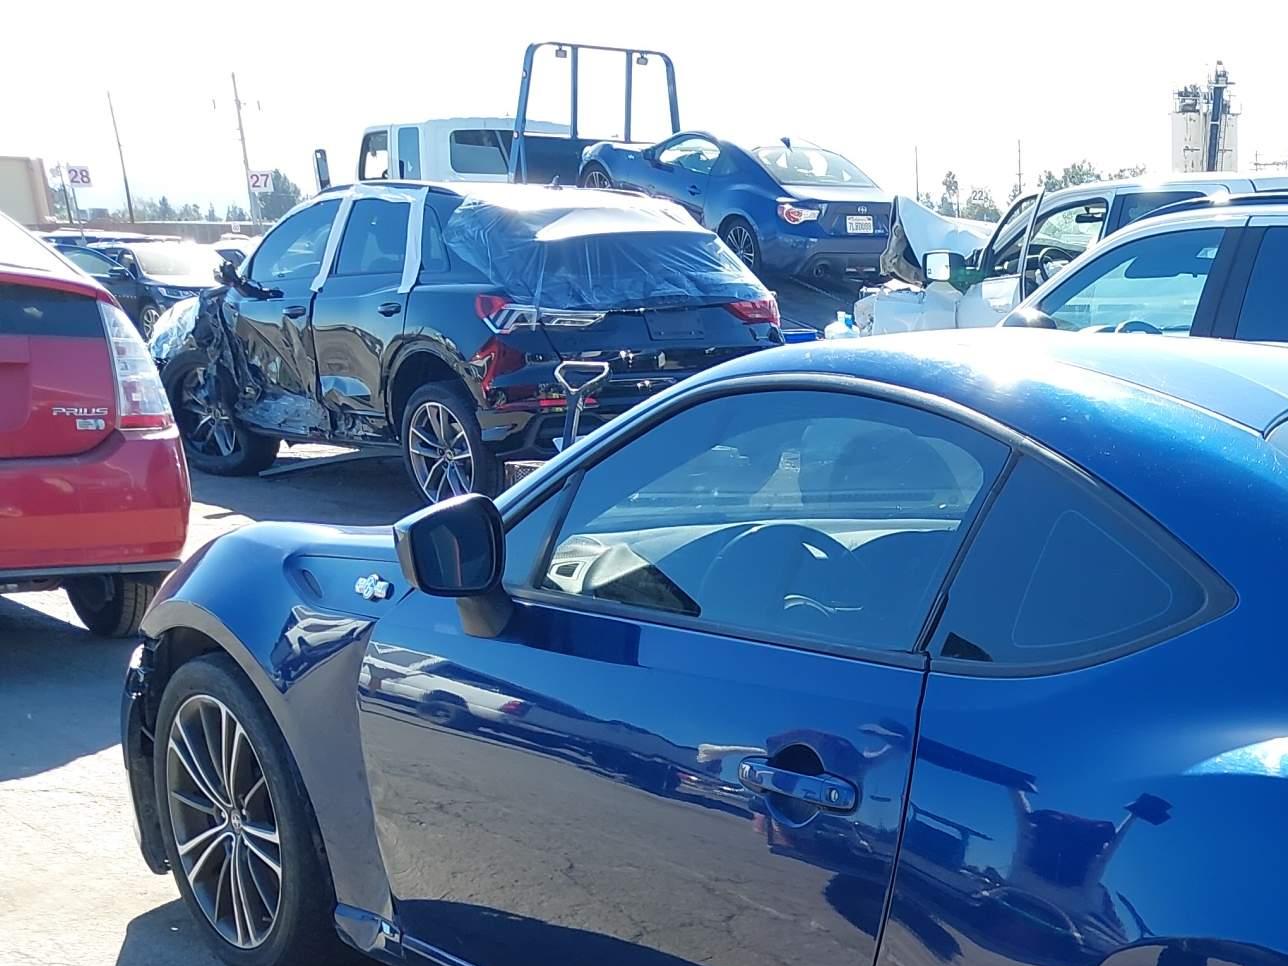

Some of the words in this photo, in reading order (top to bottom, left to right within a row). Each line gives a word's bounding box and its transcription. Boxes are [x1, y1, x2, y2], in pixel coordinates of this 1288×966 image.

[68, 168, 91, 184] 28
[250, 173, 270, 188] 27
[971, 190, 984, 201] 22
[51, 407, 109, 416] PRIUS
